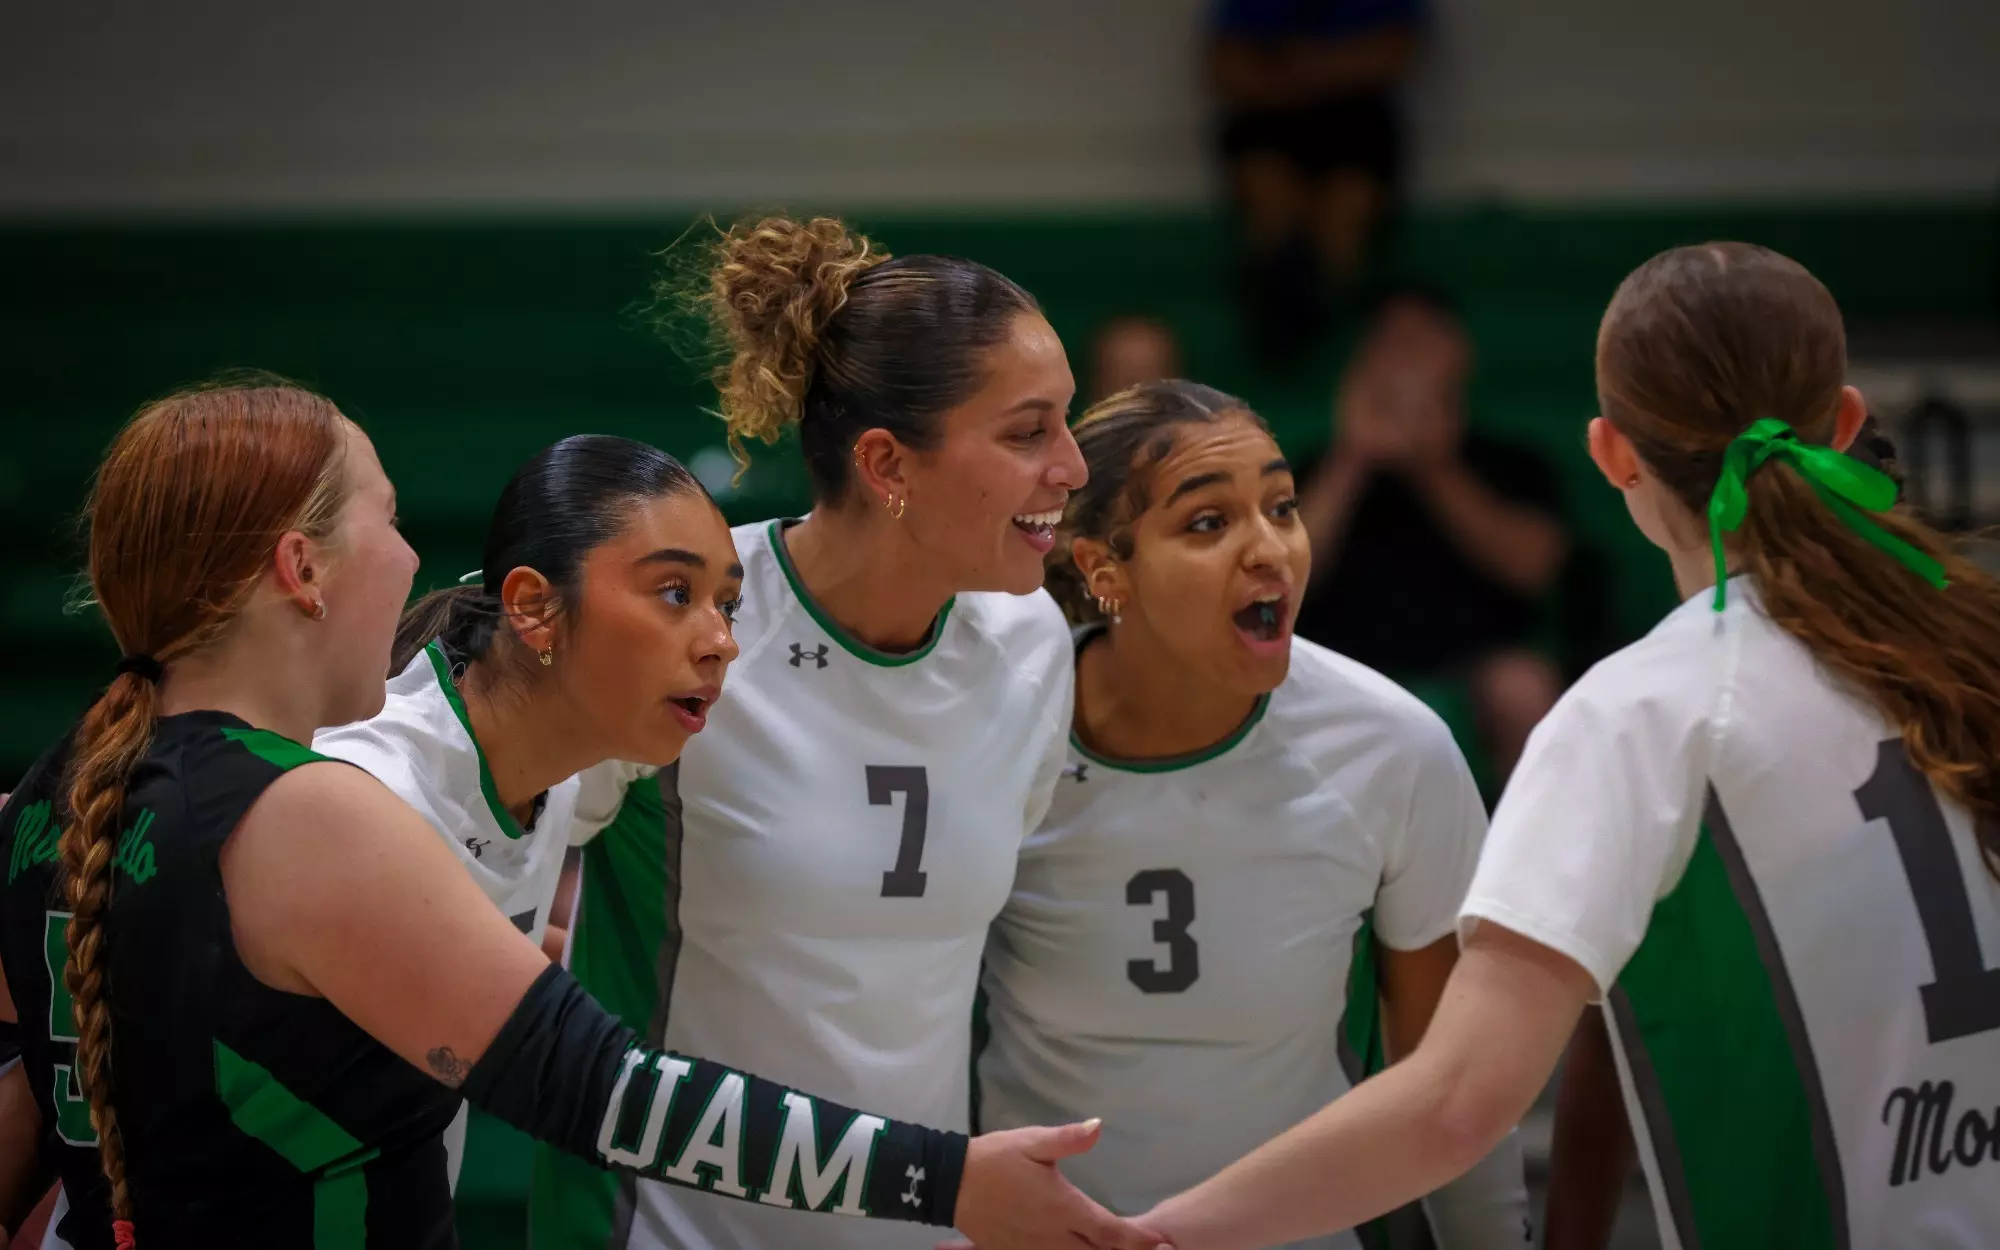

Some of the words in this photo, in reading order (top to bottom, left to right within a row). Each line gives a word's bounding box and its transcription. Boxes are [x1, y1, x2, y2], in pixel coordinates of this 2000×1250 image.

[864, 764, 930, 898] 7
[1125, 867, 1200, 995] 3
[596, 1044, 890, 1217] UAM
